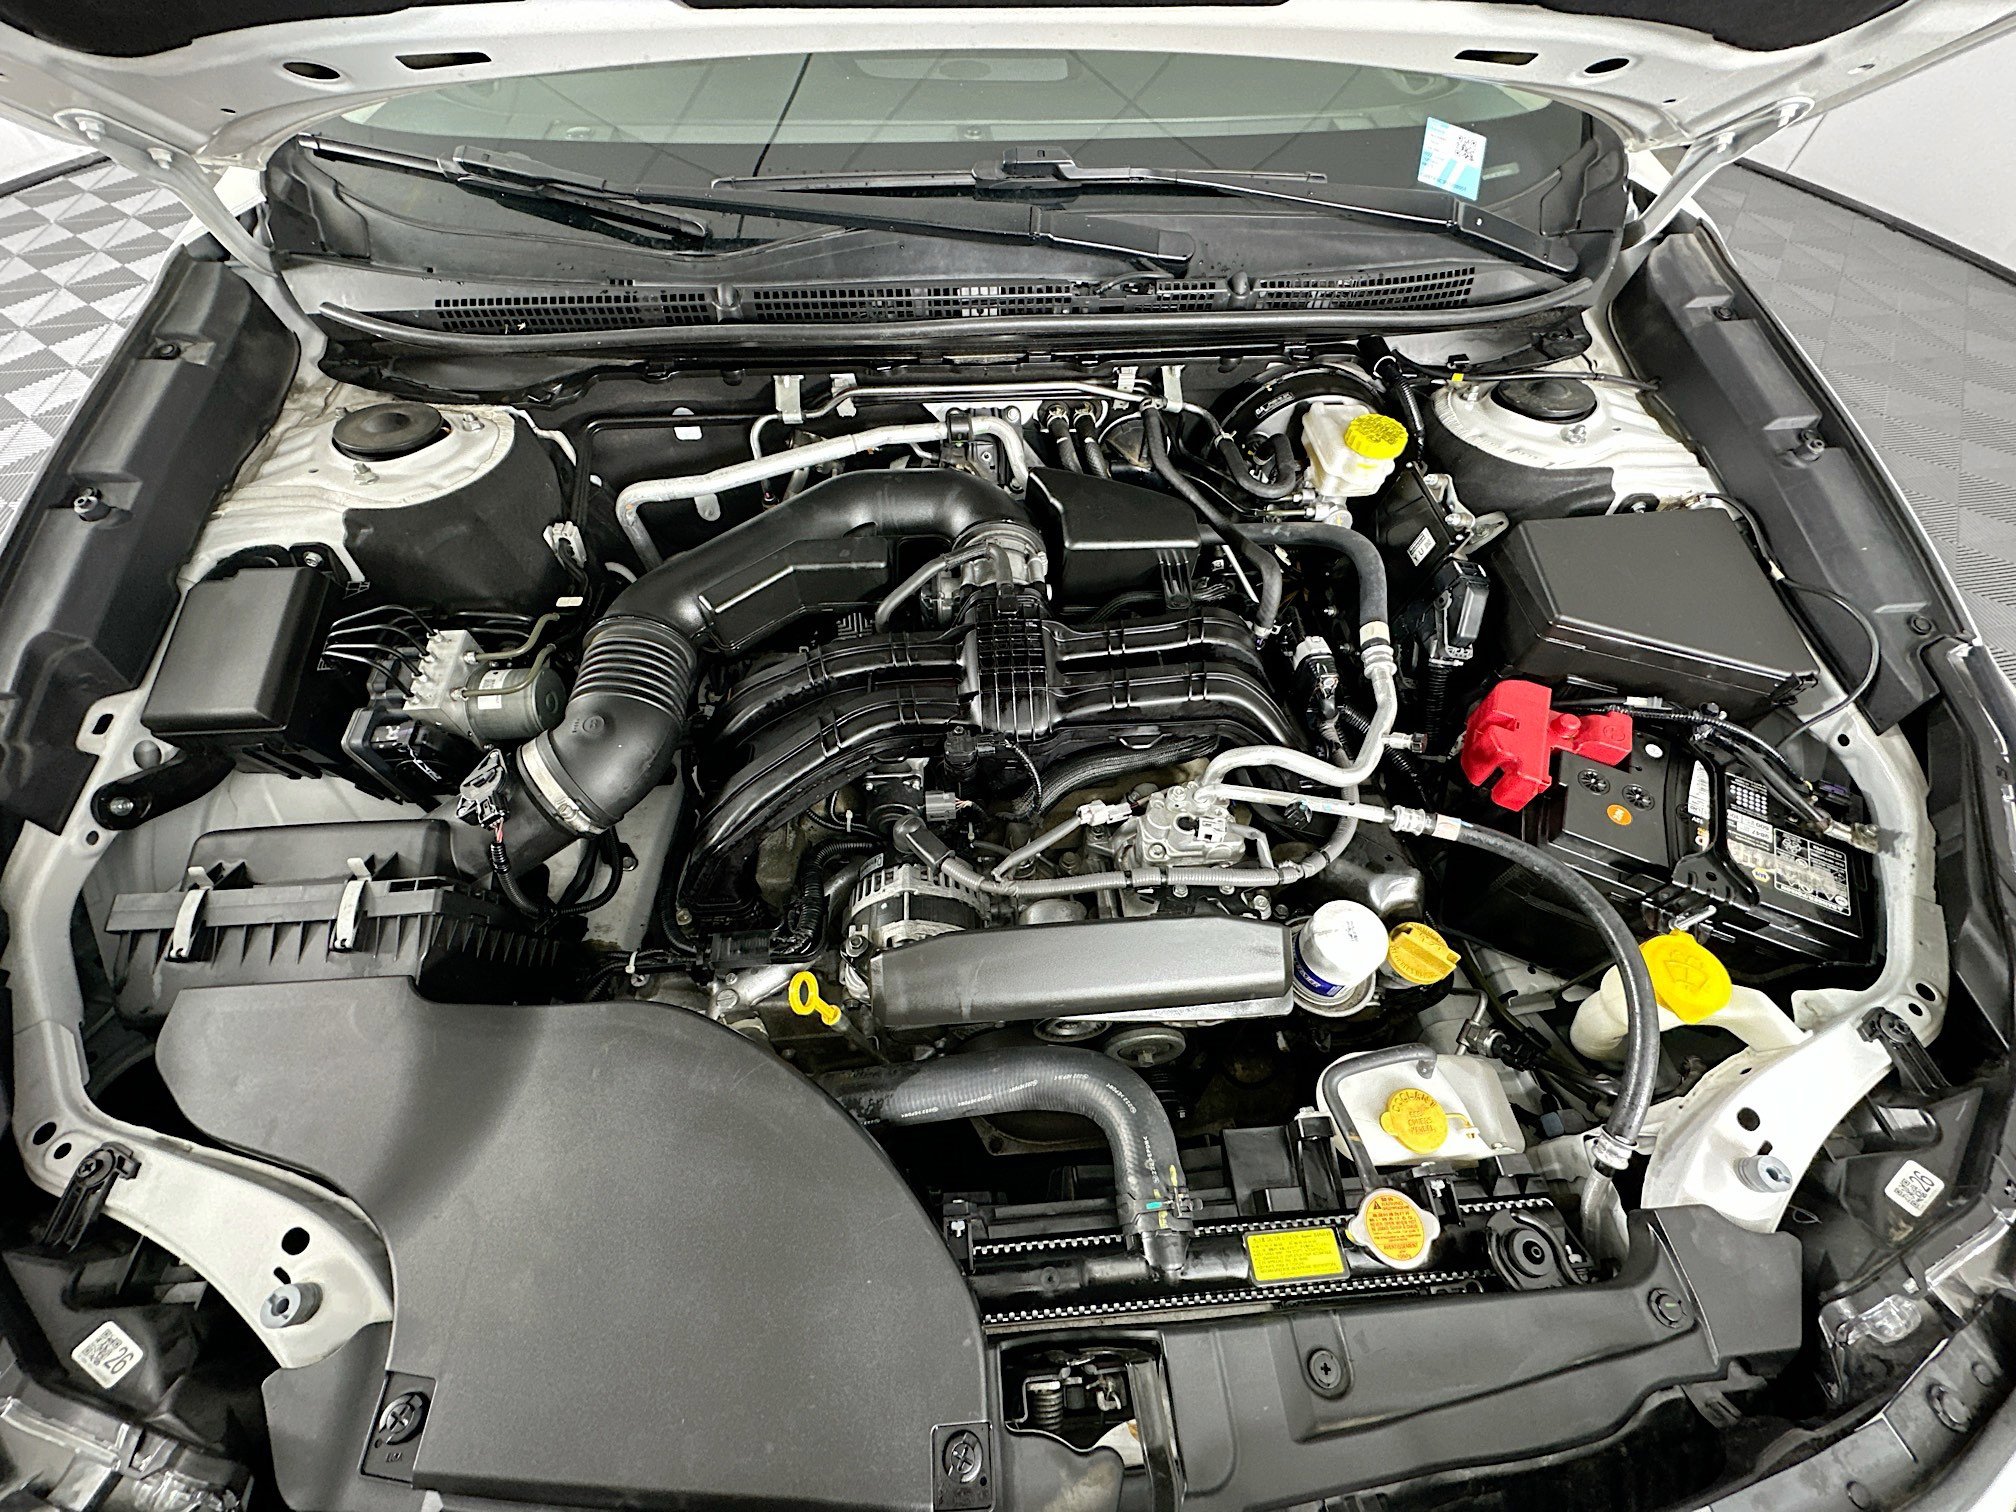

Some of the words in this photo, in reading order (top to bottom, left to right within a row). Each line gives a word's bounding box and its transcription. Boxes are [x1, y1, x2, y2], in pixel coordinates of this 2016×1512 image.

[1391, 1091, 1438, 1112] COOLANT
[1909, 1170, 1935, 1192] 26
[103, 1346, 135, 1375] 26
